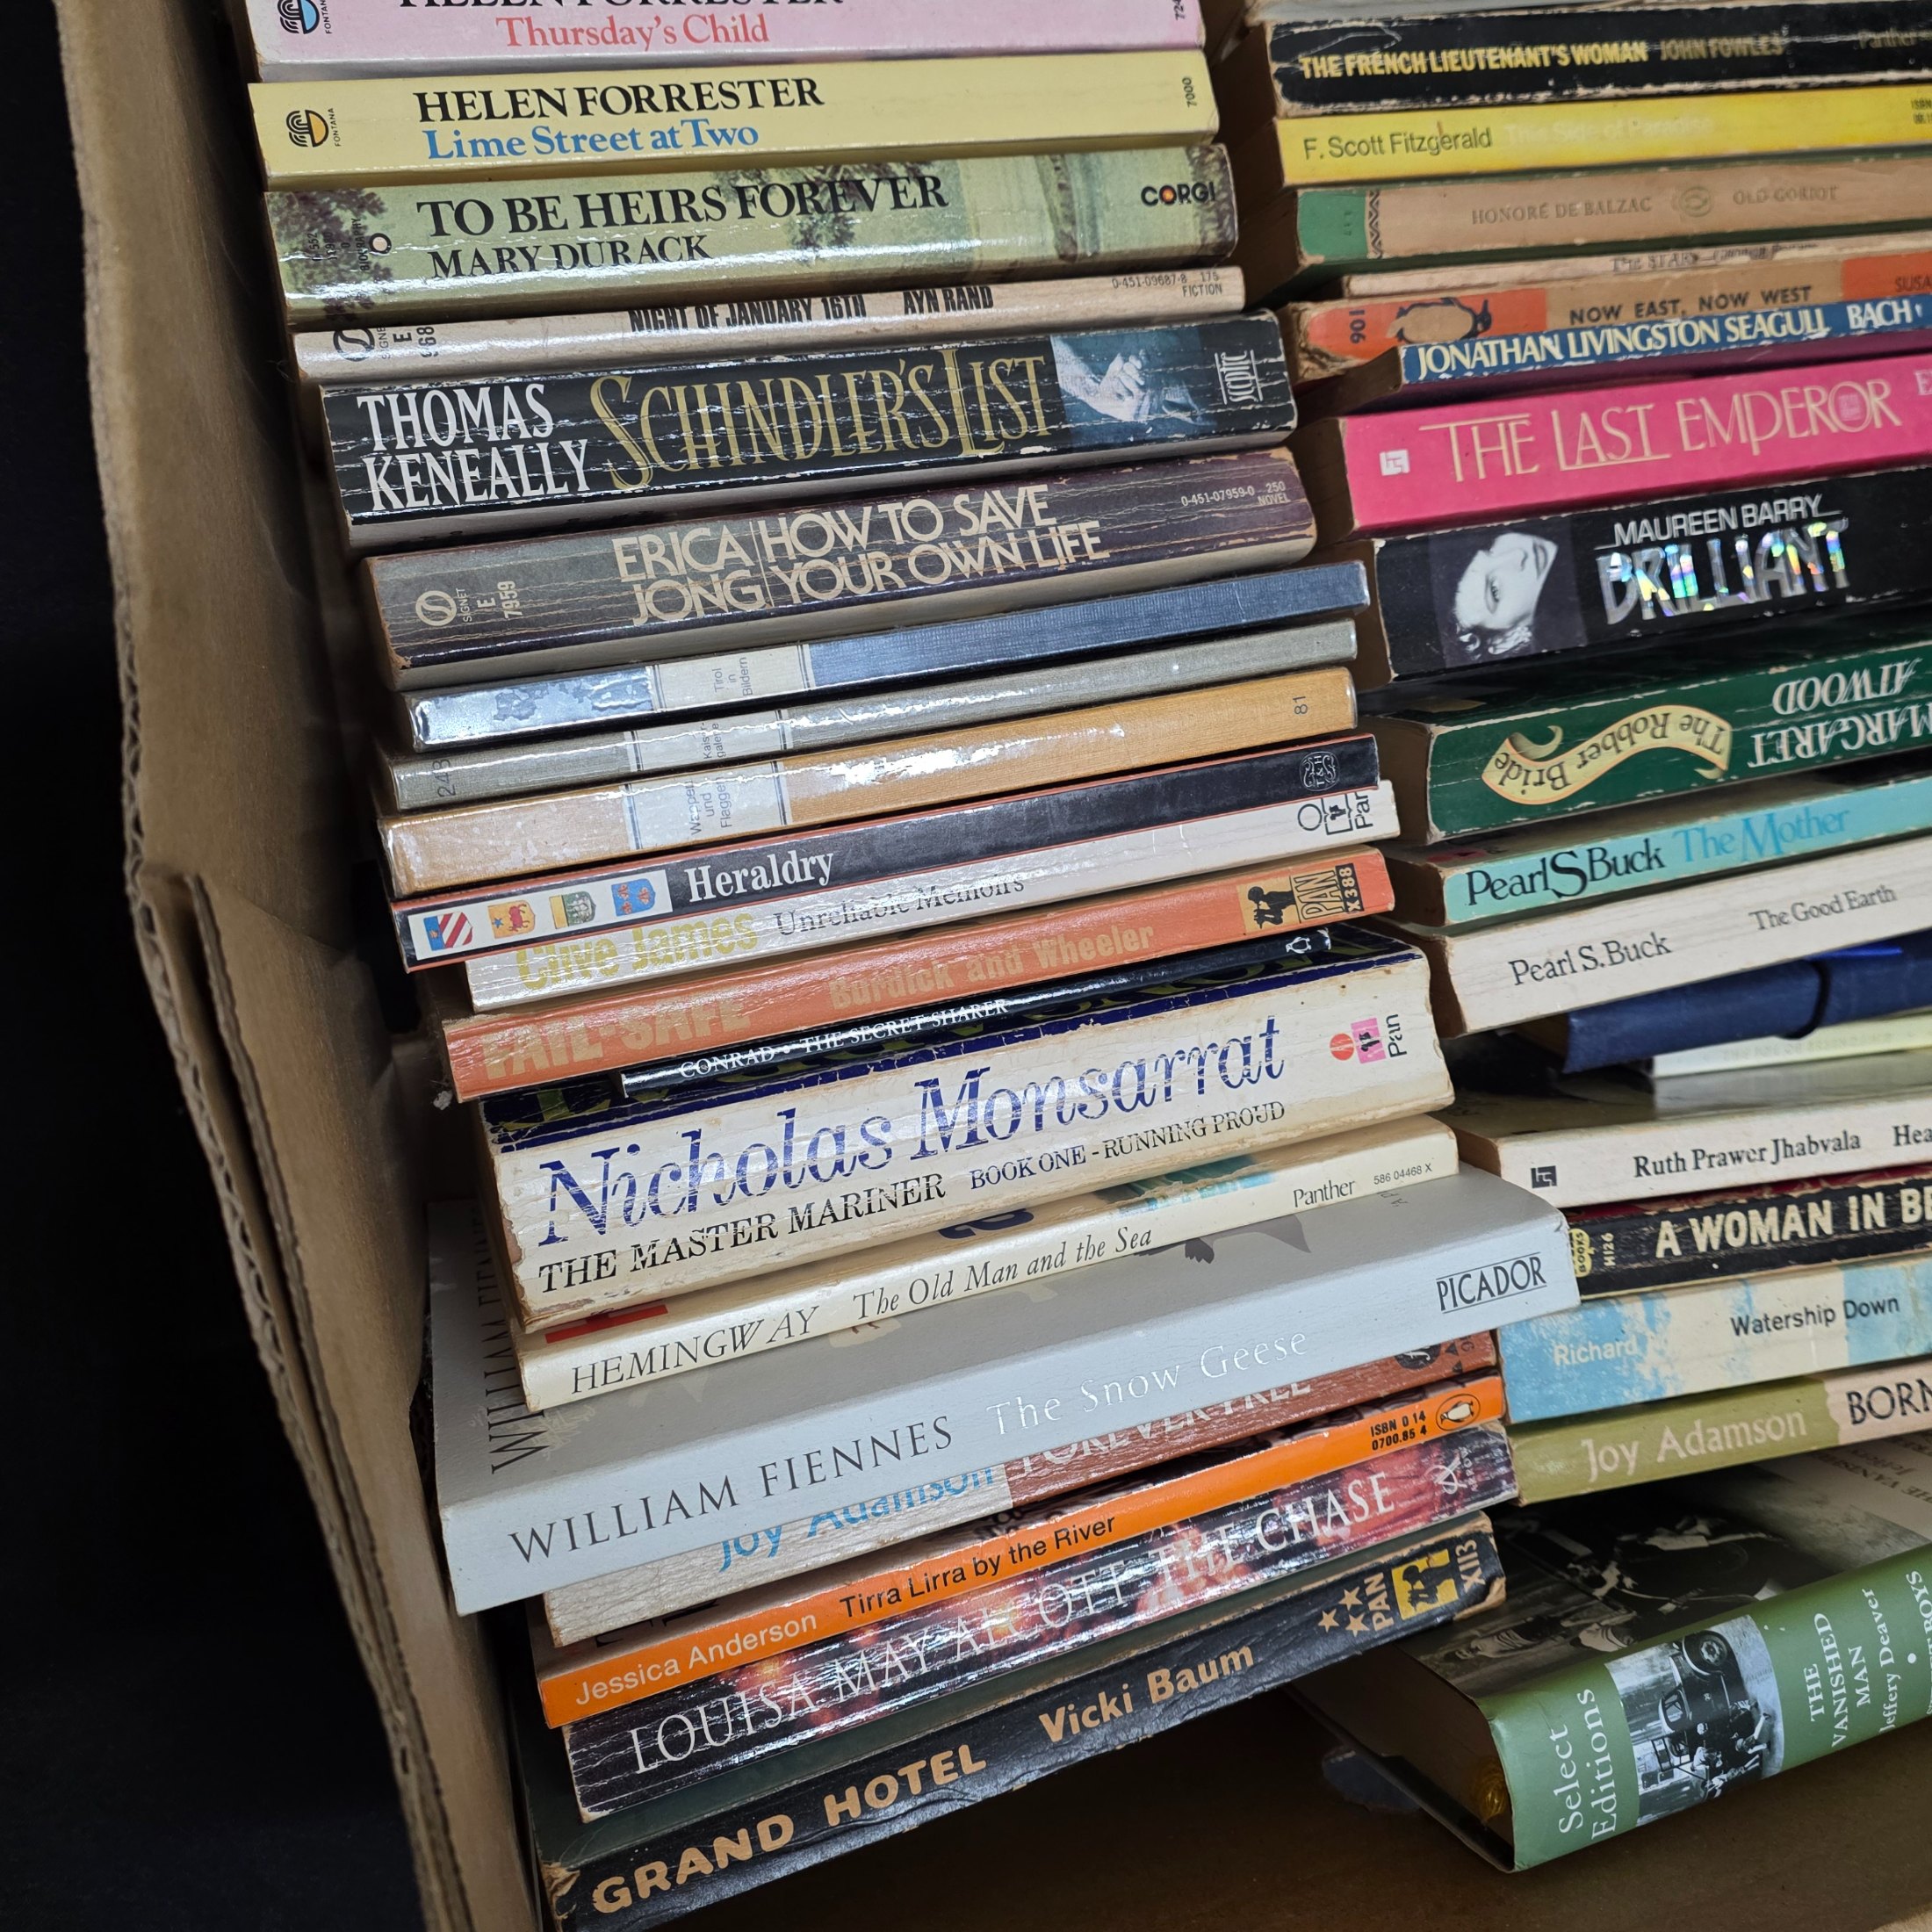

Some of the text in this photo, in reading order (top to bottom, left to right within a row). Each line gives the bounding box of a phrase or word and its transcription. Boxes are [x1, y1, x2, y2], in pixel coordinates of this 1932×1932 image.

[495, 13, 770, 51] Thursday's Child
[1298, 32, 1785, 79] THE FRENCH LIEUTENANT'S WOMAN JOHN FOWLES
[412, 76, 825, 123] HELEN FORRESTER
[1181, 76, 1197, 108] 7000
[327, 107, 342, 148] FONTANA
[422, 118, 760, 160] Lime Street Two
[1327, 126, 1492, 159] Scott Fitzgerald
[415, 174, 949, 238] TO BE HEIRS FOREVER
[1141, 182, 1216, 207] CORGI
[1472, 196, 1653, 226] HONORÉ DE BALZAC
[1732, 187, 1770, 205] OLD
[428, 234, 714, 278] MARY DURACK
[1111, 272, 1188, 290] 0-451-09687-8
[628, 285, 994, 332] NIGHT JANUARY 16TH AYN RAND
[1181, 283, 1223, 298] FICTION
[1568, 285, 1812, 325] NOW EAST, NOW WEST
[1417, 298, 1914, 381] JONATHAN LIVINGSTON SEAGULL BACH
[356, 349, 1049, 492] THOMAS SCHINDLER'S LIST
[1417, 378, 1903, 483] THE LAST EMPEROR
[360, 438, 590, 512] KENEALLY
[1179, 480, 1287, 508] 0-451-07959-0 250
[1257, 493, 1291, 507] NOVEL
[610, 483, 1056, 584] ERICA HOW TO SAVE
[1612, 492, 1829, 548] MAUREEN BARRY
[631, 520, 1111, 628] JONG YOUR OWN LIFE
[1595, 517, 1849, 626] BRILLIANT
[454, 587, 472, 624] SIGNET
[496, 580, 523, 620] 7959
[711, 667, 724, 693] Tirol
[739, 656, 753, 696] Bildern
[1771, 657, 1923, 716] ATWOOD
[1292, 696, 1308, 715] 81
[1575, 711, 1673, 771] Robber
[700, 792, 716, 818] und
[683, 848, 834, 903] Heraldry
[1464, 805, 1851, 906] Pearl Buck The Mother
[1294, 869, 1345, 921] PAN
[631, 912, 760, 970] James
[1508, 883, 1899, 986] Pearl Buck The Good Earth
[482, 923, 1155, 1081] FAIL-SAFE Burdick and Wheeler
[680, 998, 1009, 1078] CONRAD THE SECRET SHARER
[1385, 1013, 1408, 1058] Pan
[537, 1014, 1286, 1248] Nicholas Monsarrat
[1633, 1129, 1862, 1179] Ruth Prawer Jhabvala
[538, 1248, 616, 1294] THE
[629, 1212, 779, 1272] MASTER
[787, 1172, 947, 1236] MARINER
[969, 1150, 1038, 1191] BOOK
[1038, 1144, 1086, 1174] ONE
[1103, 1116, 1209, 1160] RUNNING
[1211, 1100, 1286, 1135] PROUD
[1688, 1191, 1887, 1253] WOMAN IN
[852, 1287, 899, 1321] The
[907, 1270, 954, 1306] Old
[963, 1259, 1019, 1293] Man
[1027, 1240, 1067, 1277] and
[1075, 1234, 1107, 1263] the
[1115, 1225, 1153, 1255] Sea
[1292, 1179, 1356, 1208] Panther
[1373, 1172, 1392, 1186] 586
[1393, 1165, 1423, 1181] 04468
[1729, 1294, 1900, 1337] Watership Down
[1553, 1335, 1640, 1366] Richard
[506, 1474, 740, 1564] WILLIAM
[757, 1415, 954, 1499] FIENNES
[984, 1395, 1063, 1436] The
[1079, 1364, 1182, 1413] Snow
[1199, 1330, 1308, 1379] Geese
[1435, 1255, 1548, 1312] PICADOR
[1370, 1418, 1397, 1438] ISBN
[1581, 1409, 1808, 1484] Joy Adamson
[575, 1657, 681, 1706] Jessica
[688, 1611, 818, 1670] Anderson
[838, 1592, 903, 1620] Tirra
[907, 1567, 967, 1598] Lirra
[972, 1555, 1001, 1578] by
[1008, 1541, 1048, 1566] the
[1053, 1515, 1116, 1550] River
[627, 1471, 1396, 1775] LOUISA ALCOTT CHASE
[1363, 1571, 1395, 1632] PAN
[1861, 1588, 1895, 1669] Deaver
[1803, 1662, 1826, 1722] THE
[1813, 1612, 1849, 1748] VANISHED
[1848, 1645, 1871, 1708] MAN
[591, 1644, 1255, 1914] GRAND HOTEL Vicki Baum
[1547, 1688, 1617, 1841] Select Editions
